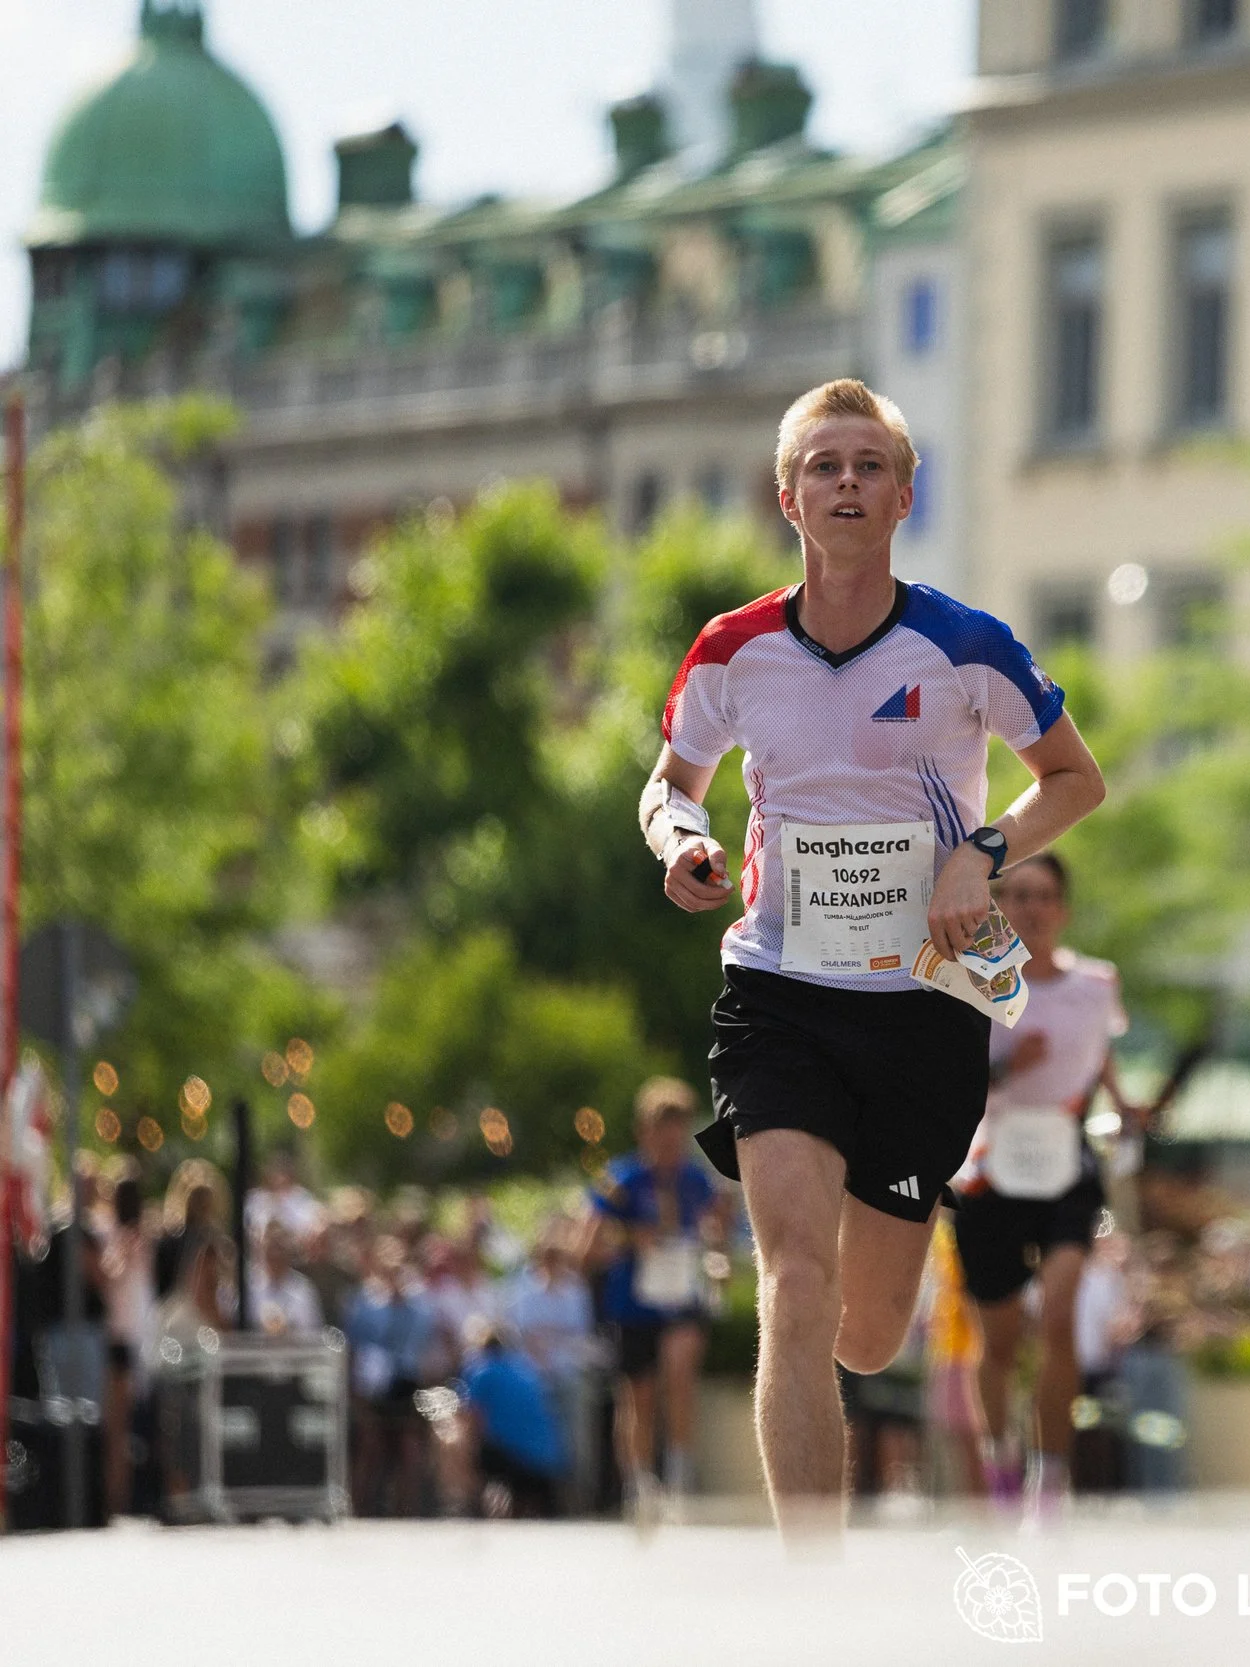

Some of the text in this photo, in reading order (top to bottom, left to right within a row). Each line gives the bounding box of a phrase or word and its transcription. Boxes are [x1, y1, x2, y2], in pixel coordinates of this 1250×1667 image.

[796, 837, 910, 858] bagheera
[832, 868, 880, 884] 10692
[809, 888, 908, 907] ALEXANDER
[820, 960, 862, 968] CHALMERS
